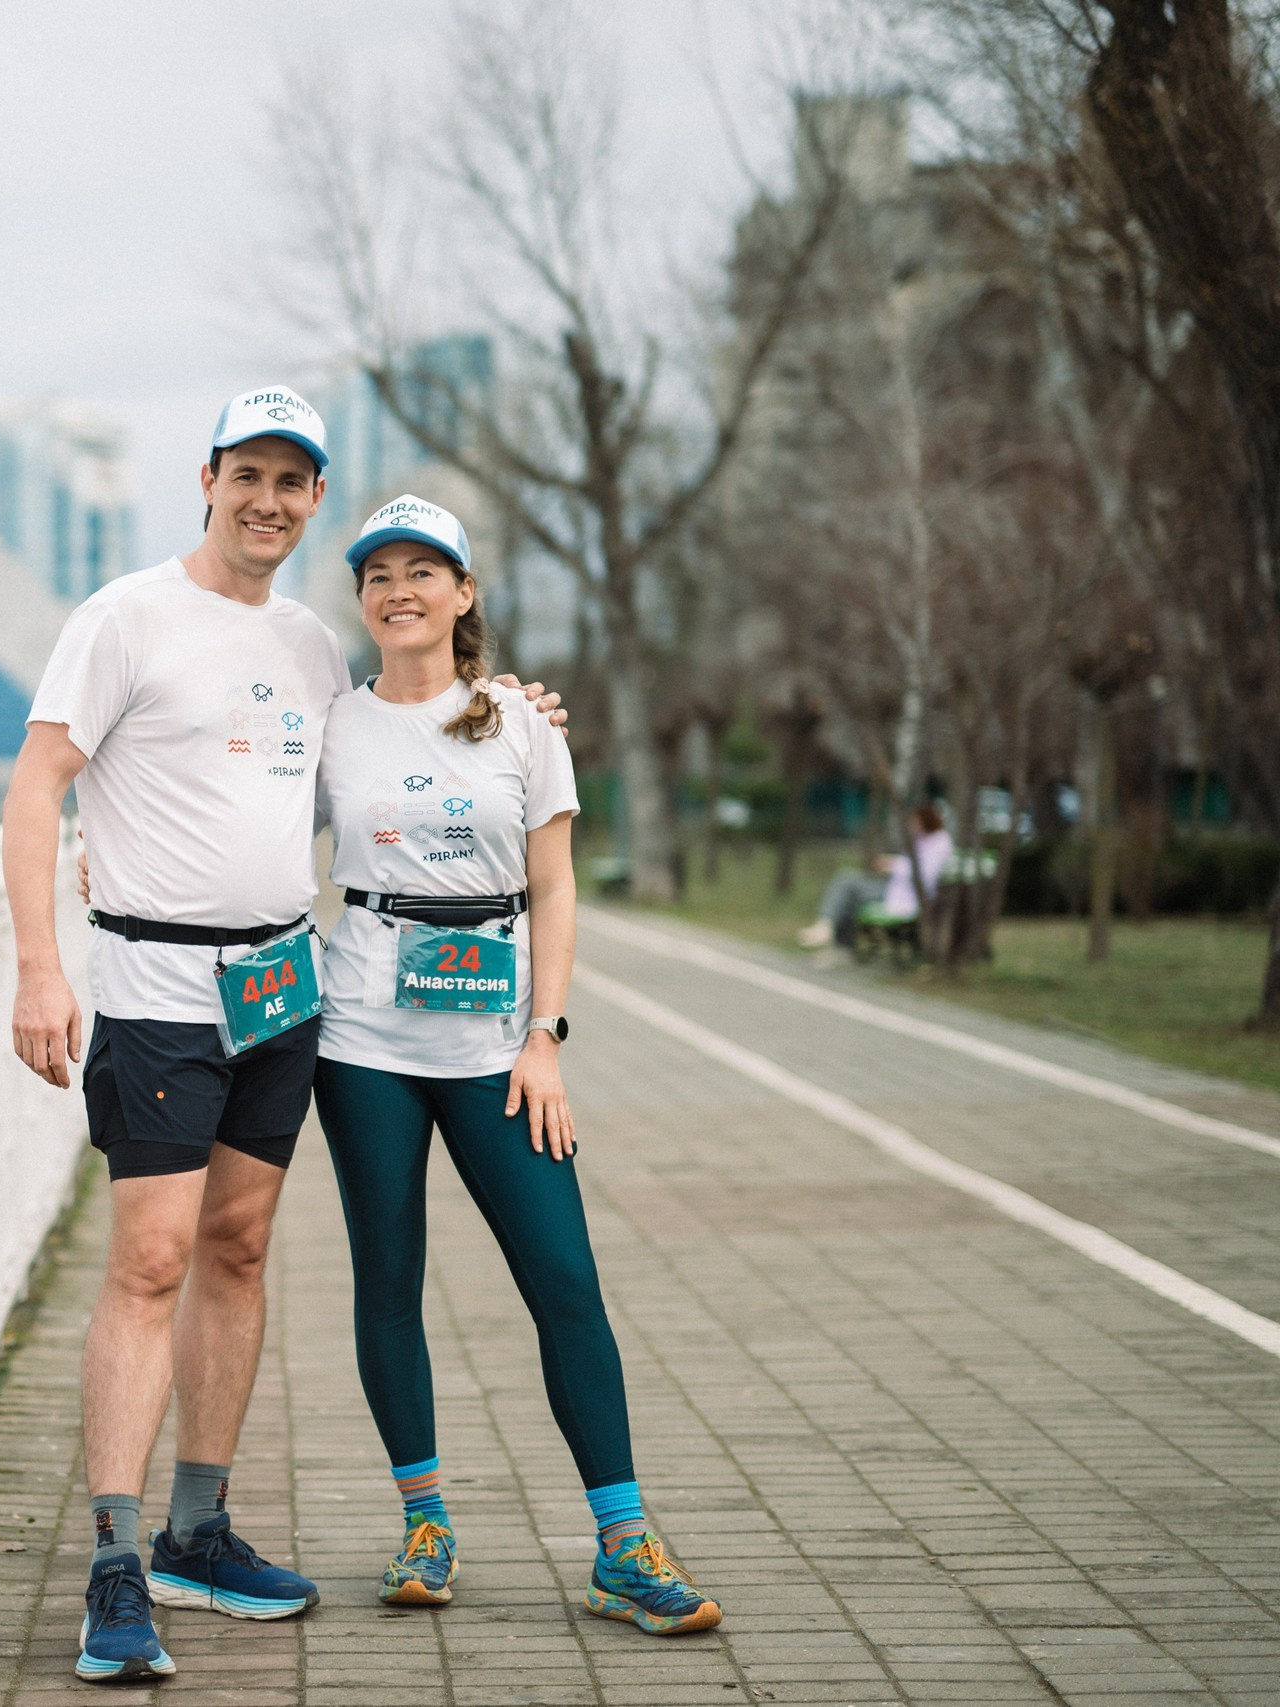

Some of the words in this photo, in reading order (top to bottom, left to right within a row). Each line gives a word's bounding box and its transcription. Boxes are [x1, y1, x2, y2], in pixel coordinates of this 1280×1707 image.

[437, 944, 481, 972] 24
[242, 959, 297, 1004] 444
[404, 972, 509, 992] Анастасия
[101, 1563, 126, 1576] HOKA
